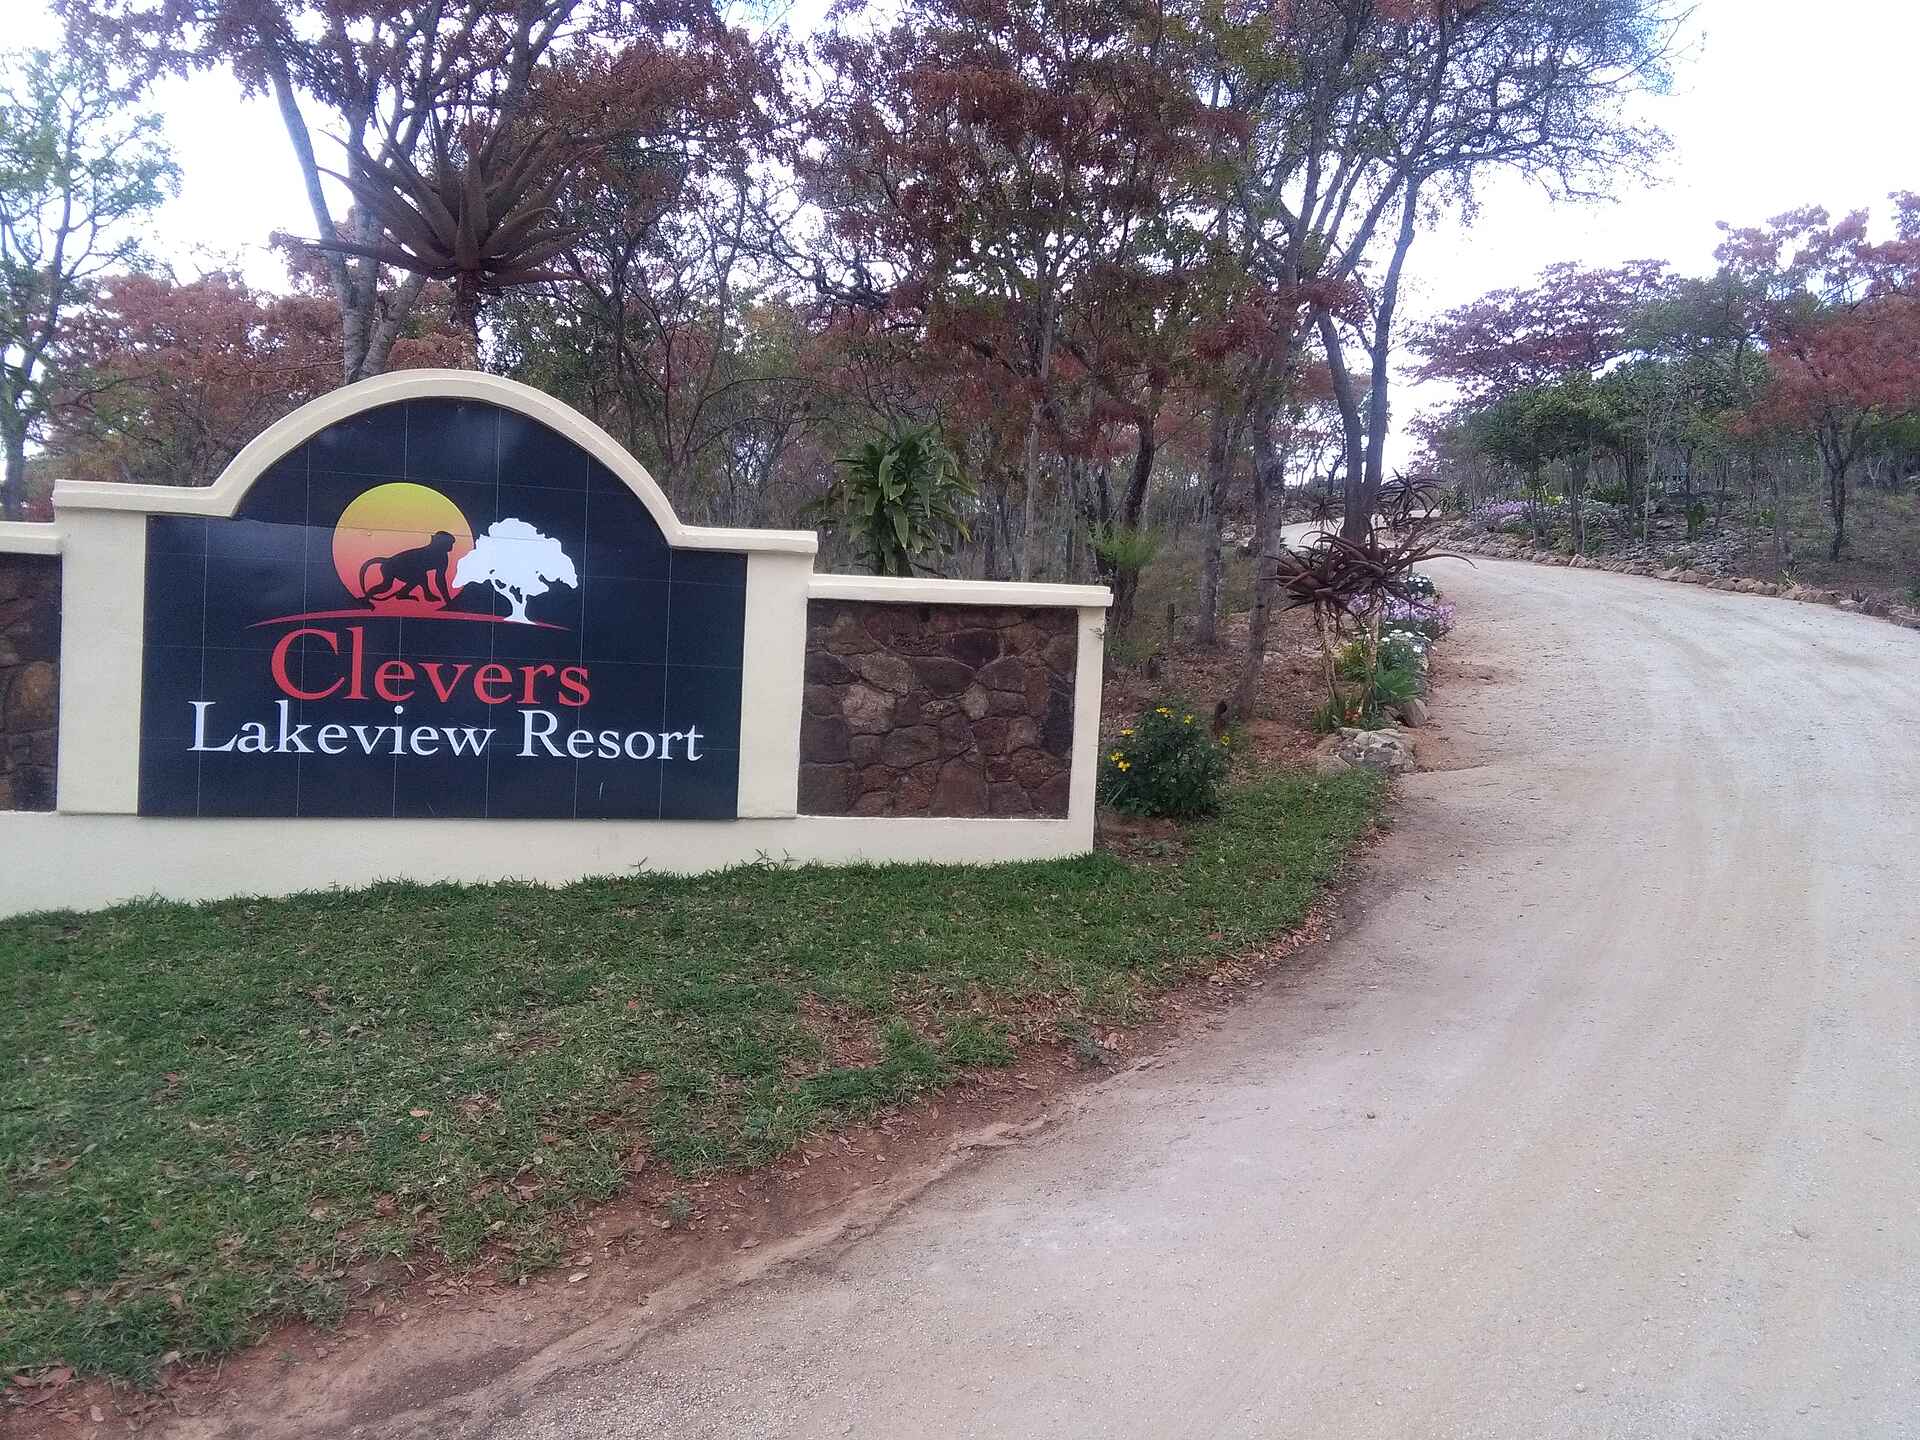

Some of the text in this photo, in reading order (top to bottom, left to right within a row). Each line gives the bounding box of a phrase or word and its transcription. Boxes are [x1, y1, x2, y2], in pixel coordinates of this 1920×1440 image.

[271, 627, 591, 706] Clevers
[187, 700, 703, 762] Lakeview Resort
